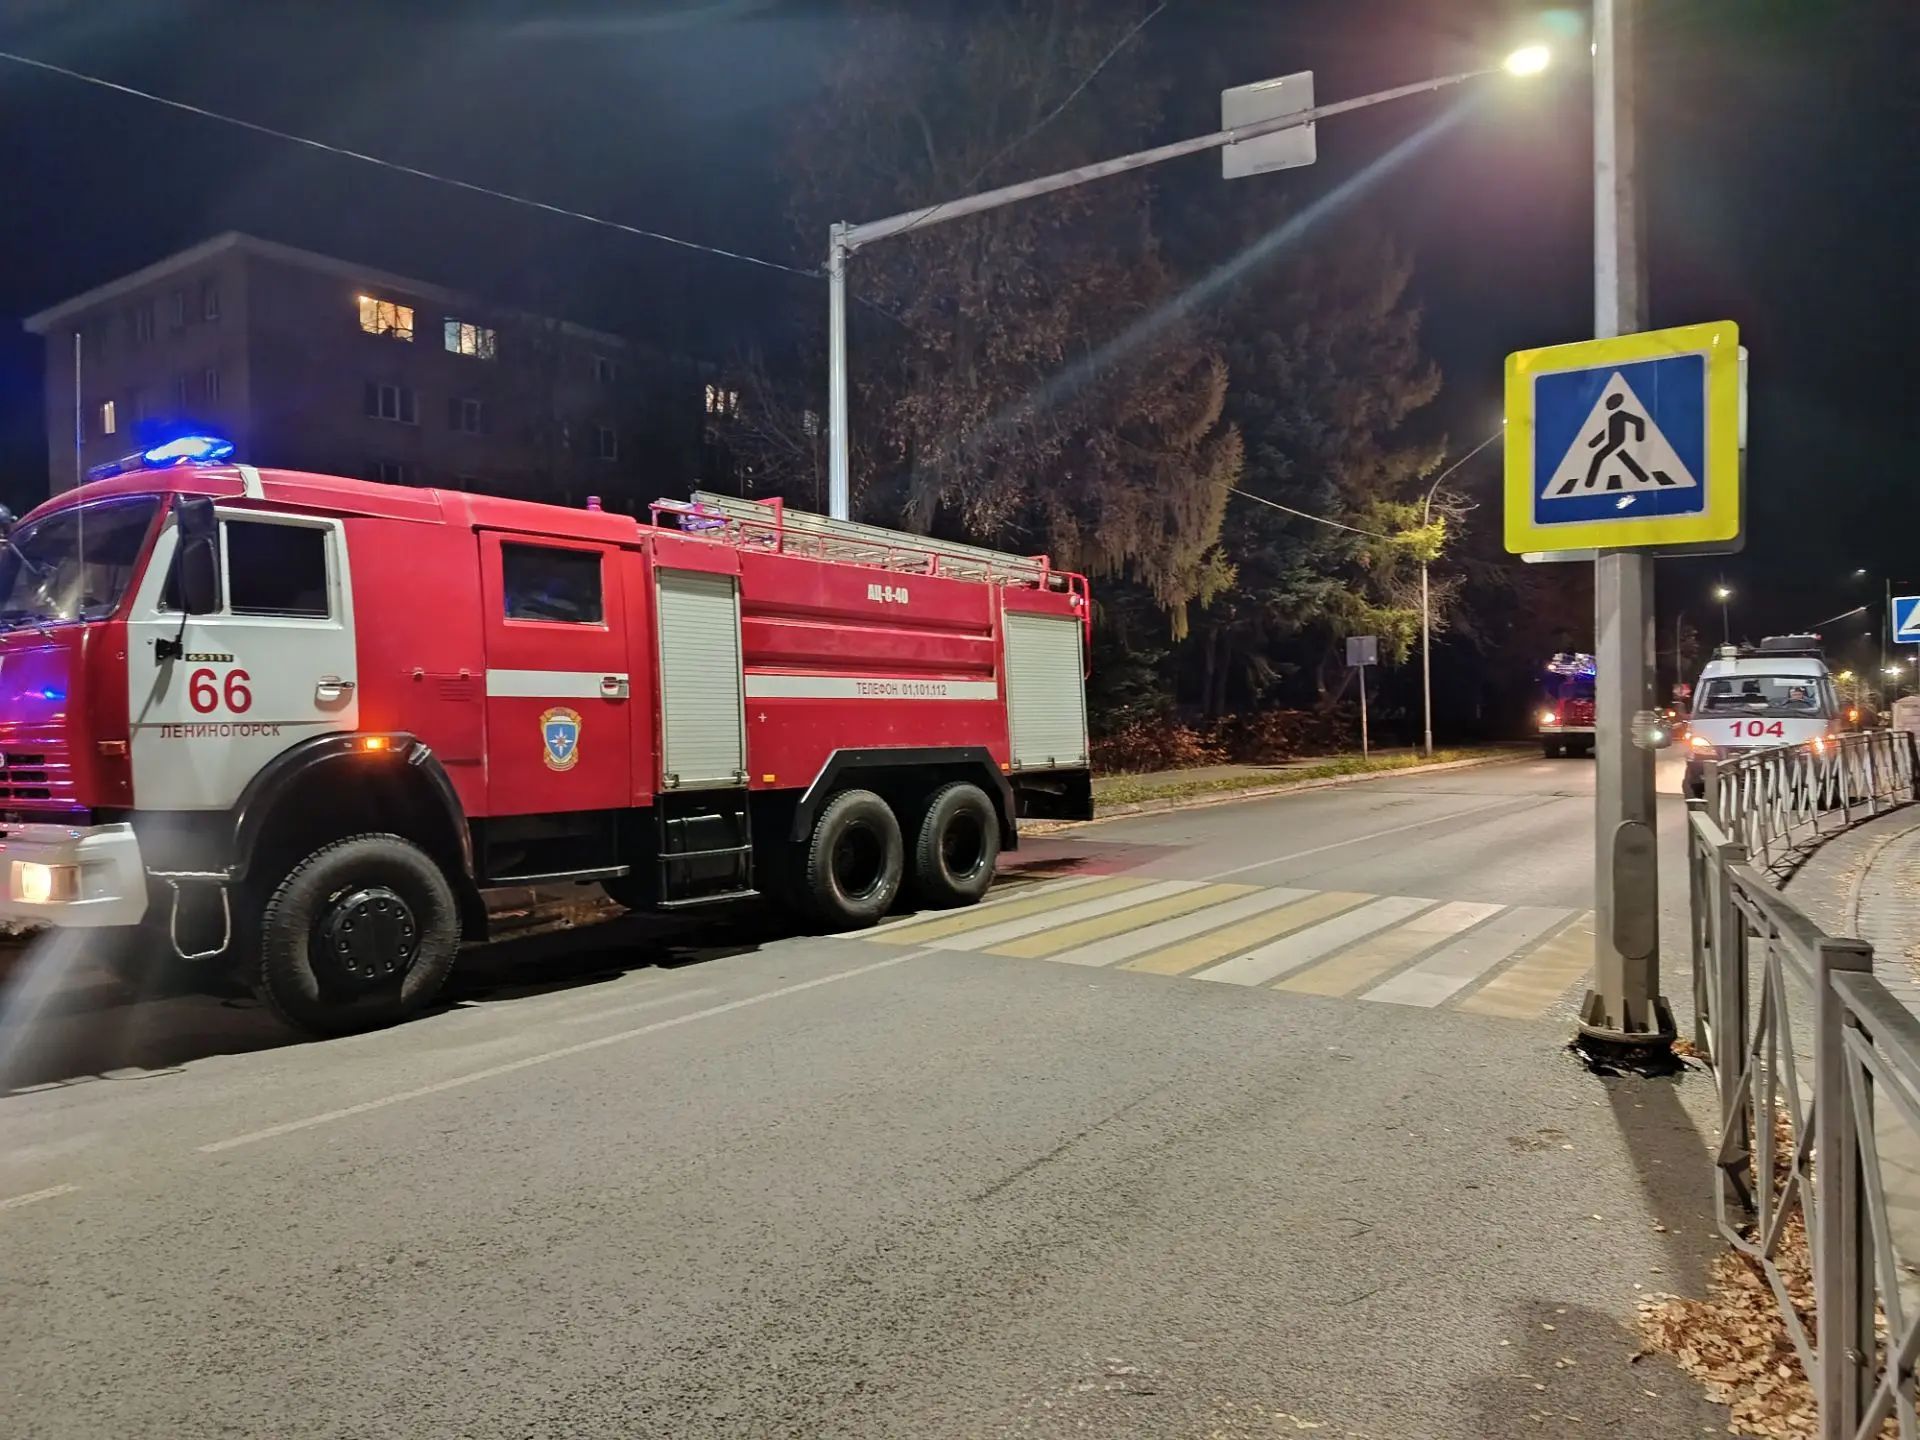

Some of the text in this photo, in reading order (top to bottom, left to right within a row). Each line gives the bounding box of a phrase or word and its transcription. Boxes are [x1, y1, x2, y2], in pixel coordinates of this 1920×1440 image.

[867, 584, 909, 604] АЦ-8-40
[189, 668, 252, 714] 66
[856, 682, 898, 694] ТЕЛЕФОН
[160, 723, 281, 738] ЛЕНИНОГОРСК
[1729, 720, 1784, 738] 104
